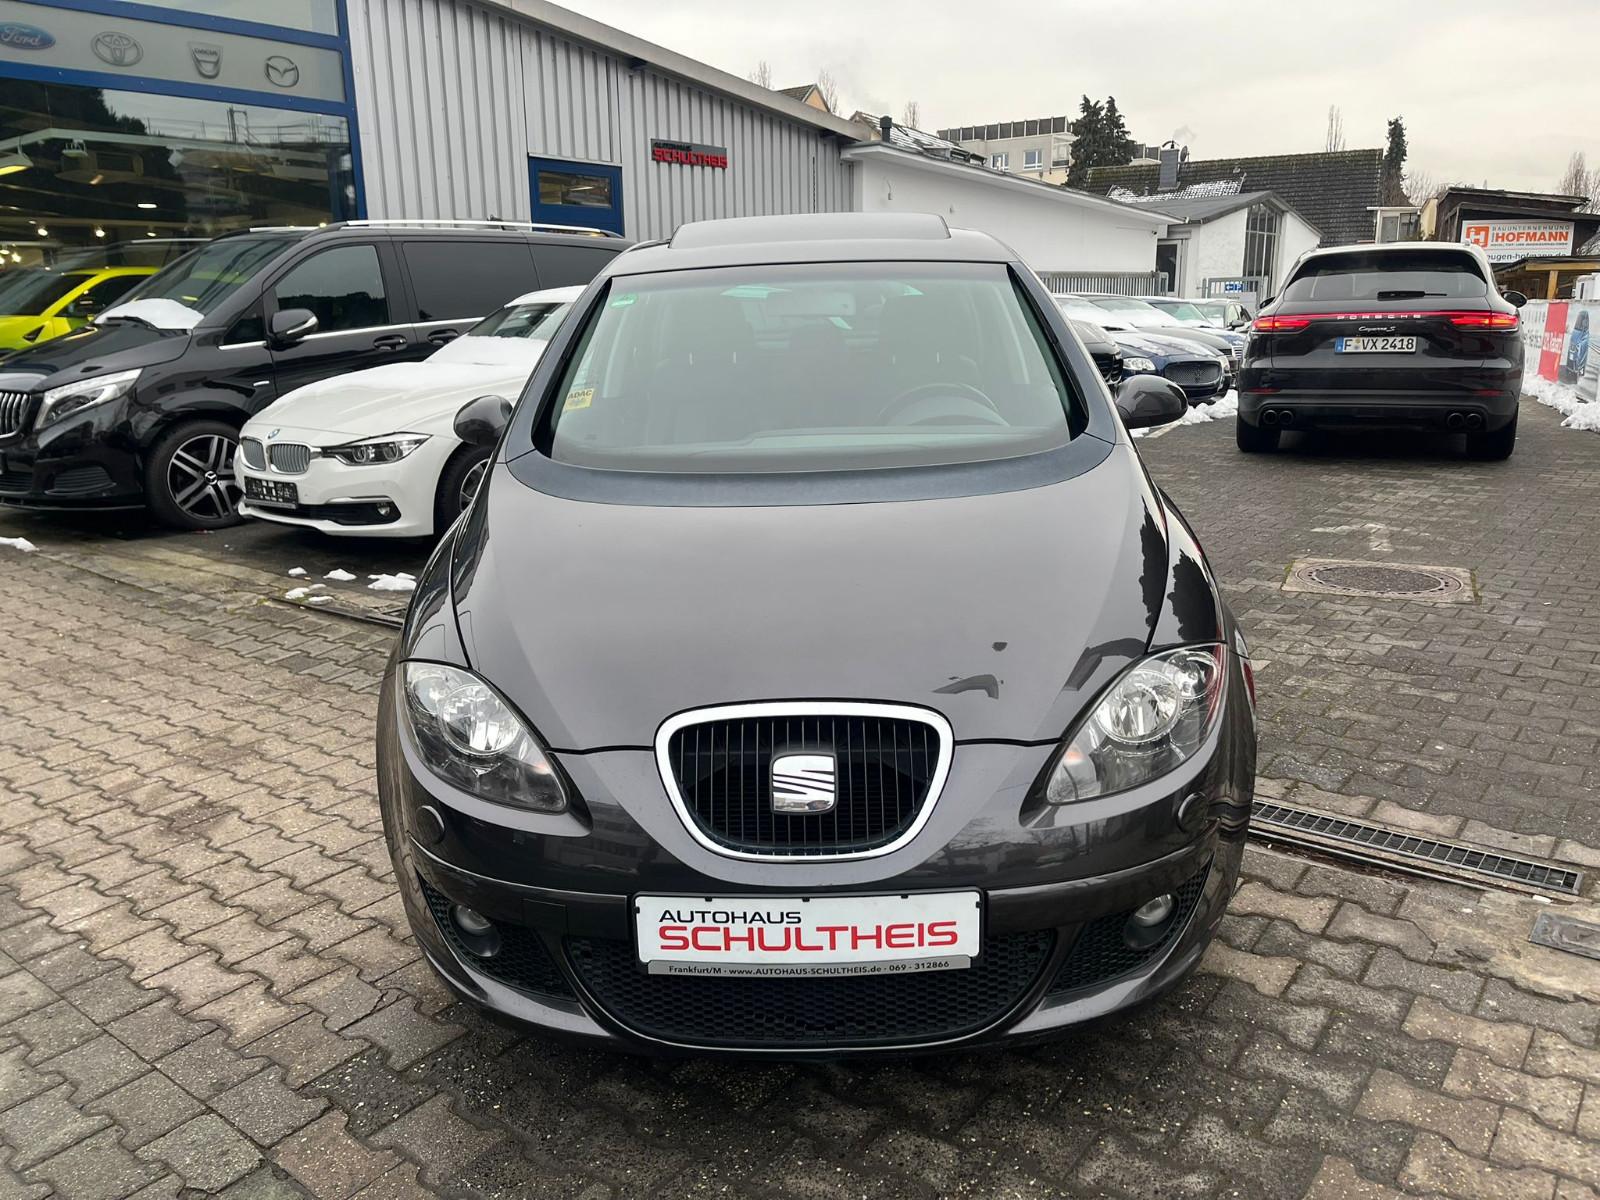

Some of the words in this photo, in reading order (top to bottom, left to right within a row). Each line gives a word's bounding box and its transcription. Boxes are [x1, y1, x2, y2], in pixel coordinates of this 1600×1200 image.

[1, 26, 41, 46] Ford
[653, 147, 728, 168] SCHULTHEIS
[1492, 224, 1570, 232] BAUUNTERNEHMUNG
[1495, 231, 1569, 242] HOFMANN
[1344, 338, 1353, 350] F
[1362, 338, 1378, 350] VX
[1381, 338, 1414, 350] 2418
[659, 910, 801, 924] AUTOHAUS
[659, 921, 958, 951] SCHULTHEIS
[669, 965, 722, 975] Frankfurt/M
[729, 965, 882, 976] www.AUTOHAUS-SCHULTHEIS.de
[889, 964, 906, 972] 069
[915, 961, 949, 970] 312866
